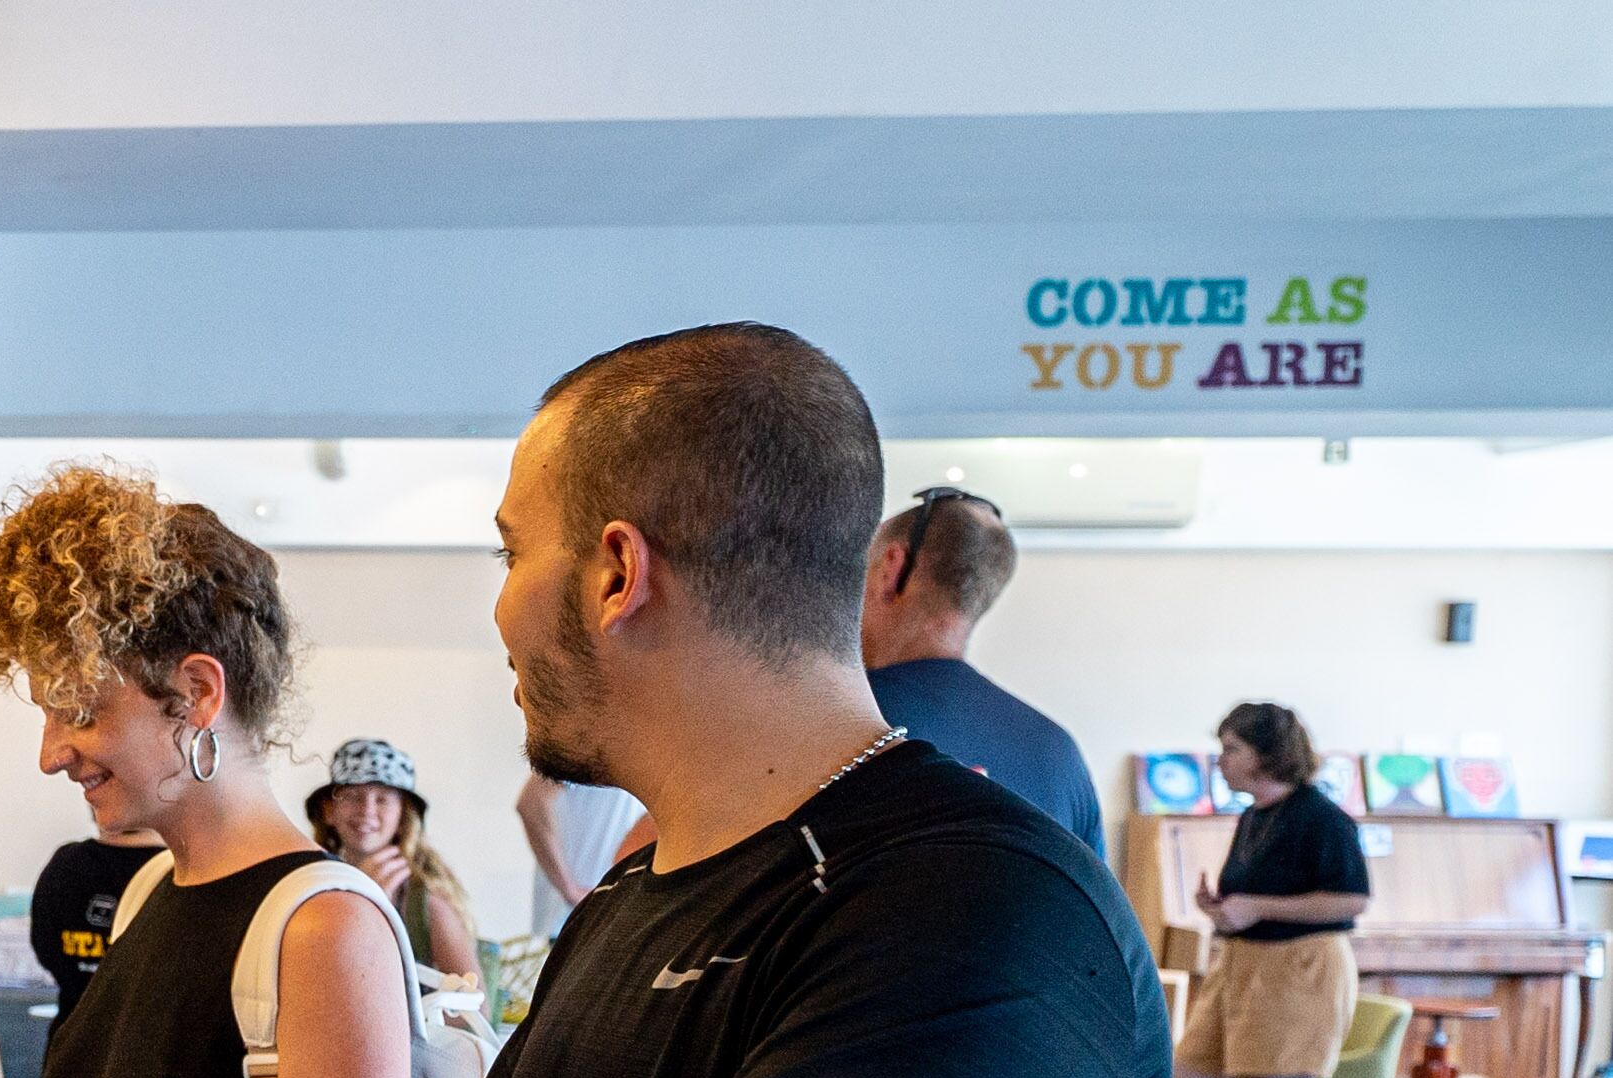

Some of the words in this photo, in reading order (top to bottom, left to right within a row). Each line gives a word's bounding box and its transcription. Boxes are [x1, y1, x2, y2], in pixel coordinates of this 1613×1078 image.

[1025, 277, 1248, 328] COME
[1266, 275, 1368, 325] AS
[1020, 342, 1183, 390] YOU
[1196, 341, 1363, 390] ARE
